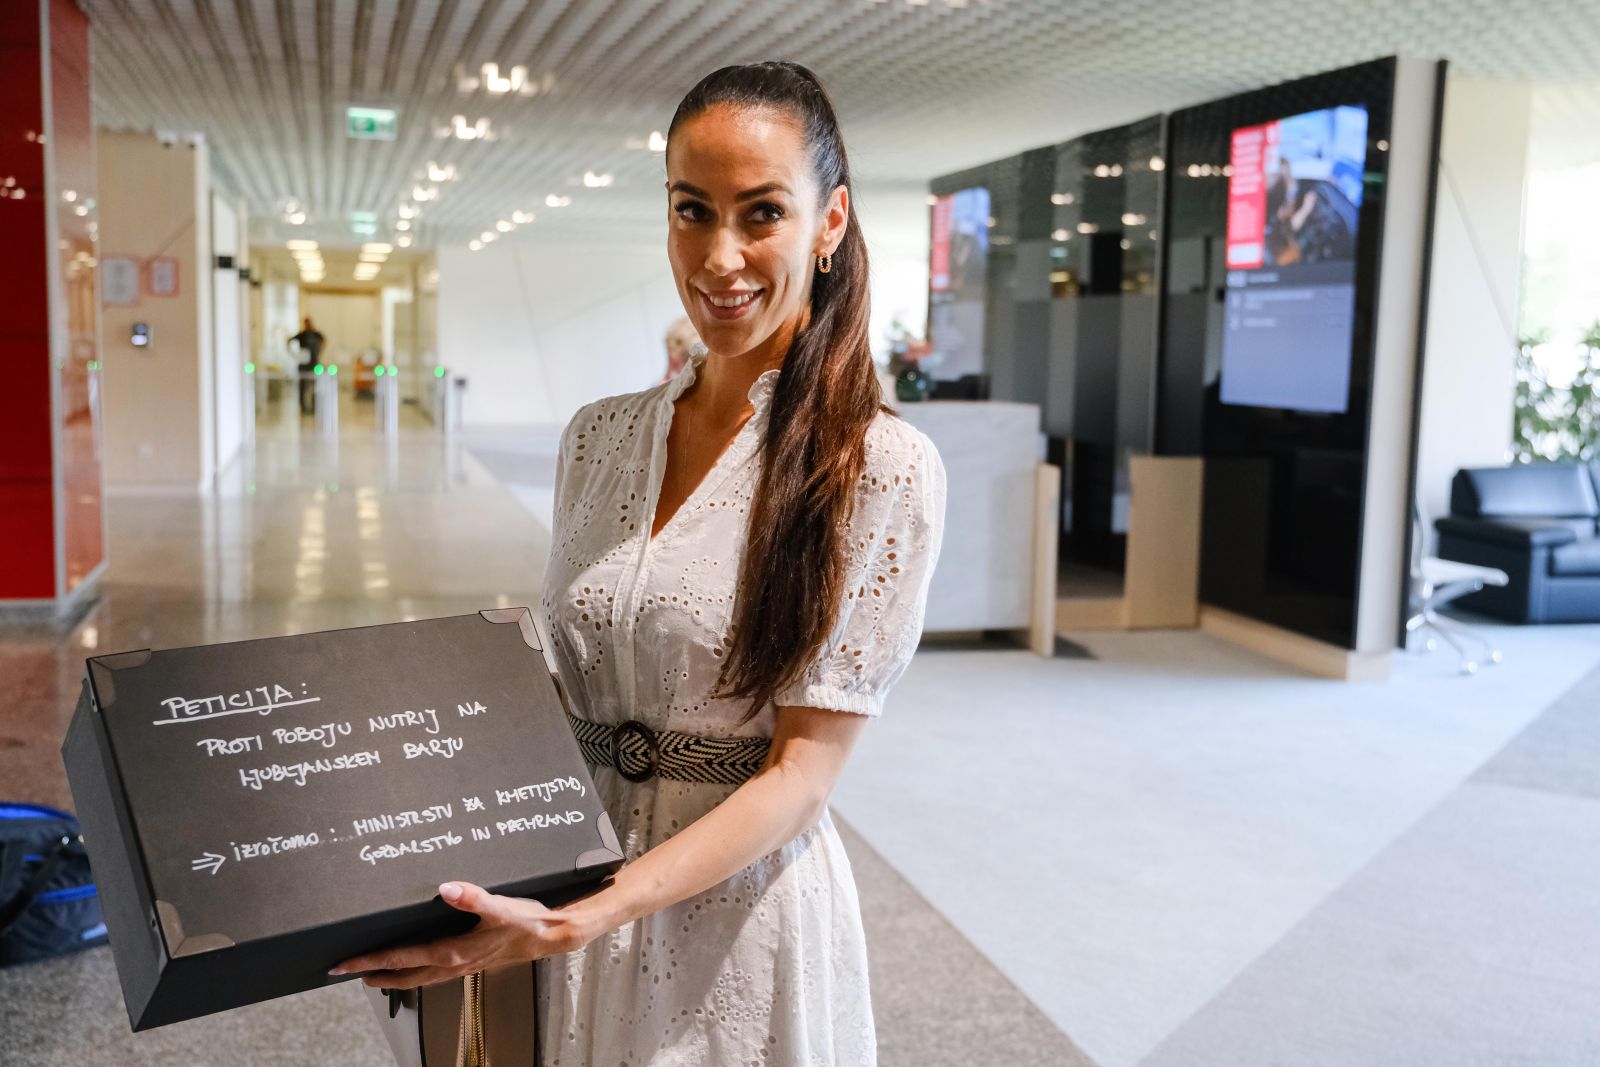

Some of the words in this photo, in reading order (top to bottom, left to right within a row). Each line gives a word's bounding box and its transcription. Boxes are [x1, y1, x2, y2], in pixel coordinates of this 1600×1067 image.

[161, 682, 307, 719] PETICIJA:
[196, 735, 263, 757] PROTI
[272, 722, 352, 748] POBOJU
[368, 709, 440, 734] NUTRIJ
[457, 701, 487, 717] NA
[238, 750, 381, 791] LJUBLJANSKEM
[402, 737, 463, 759] BARJU
[352, 803, 453, 837] MINISTRSTV
[462, 796, 486, 812] ZA
[471, 826, 491, 841] IN
[495, 810, 585, 836] PREHRANO
